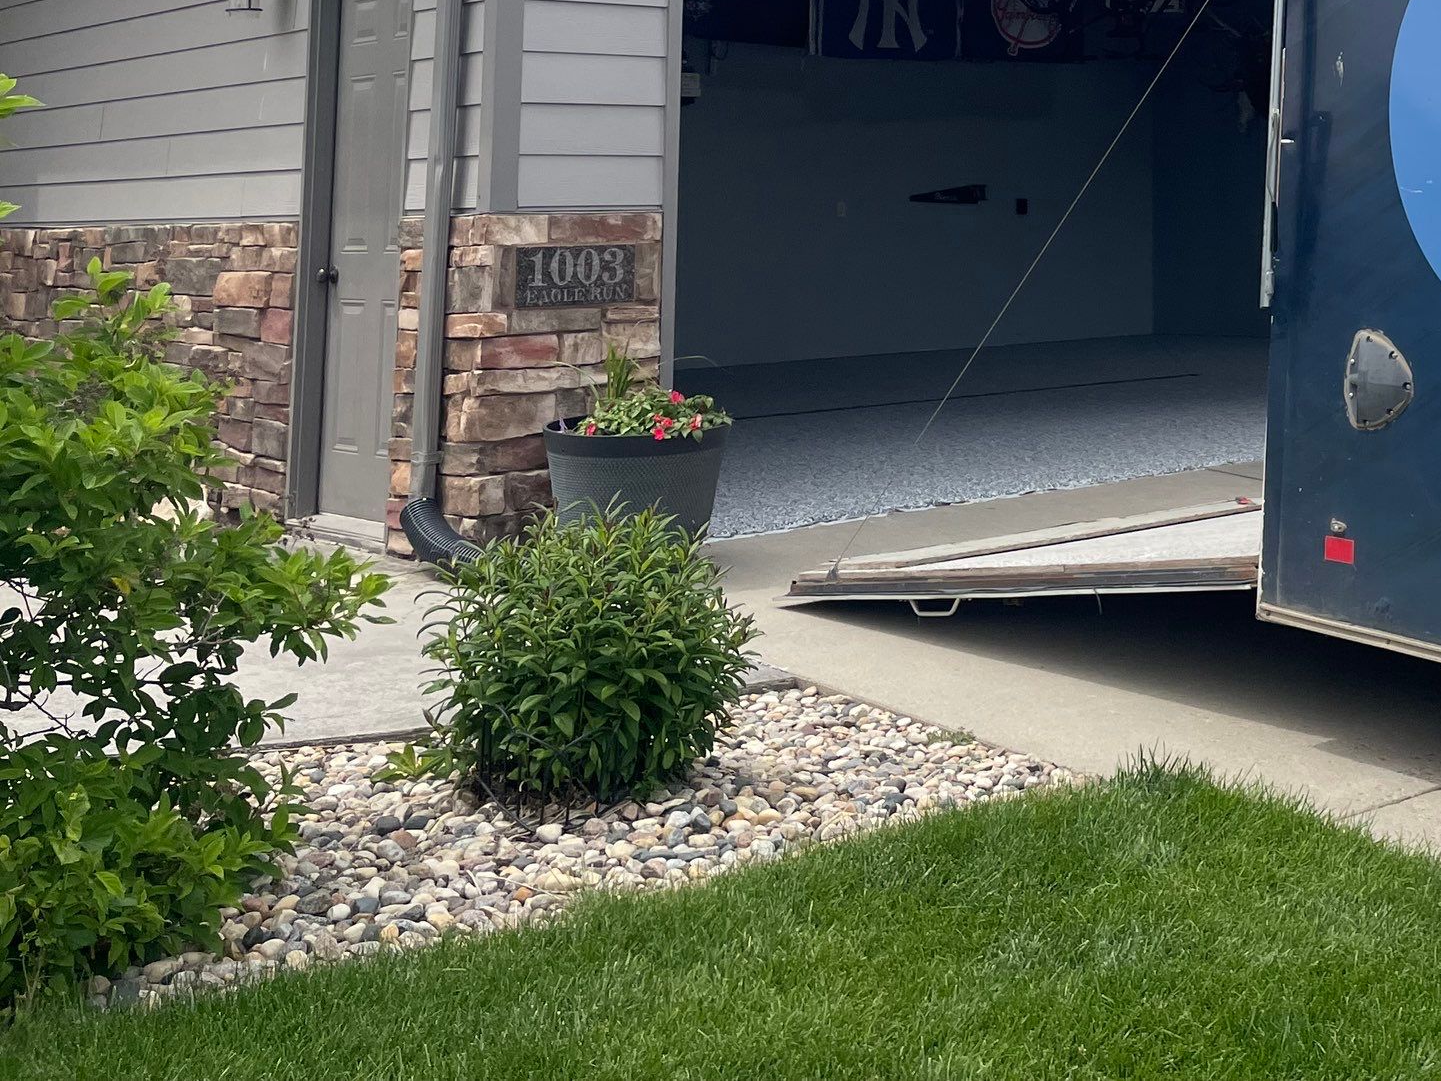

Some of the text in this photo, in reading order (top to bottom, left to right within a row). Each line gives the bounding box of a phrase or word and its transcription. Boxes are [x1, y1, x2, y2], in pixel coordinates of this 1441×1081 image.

[528, 247, 625, 287] 1003
[526, 284, 628, 304] EAGLE RUN
